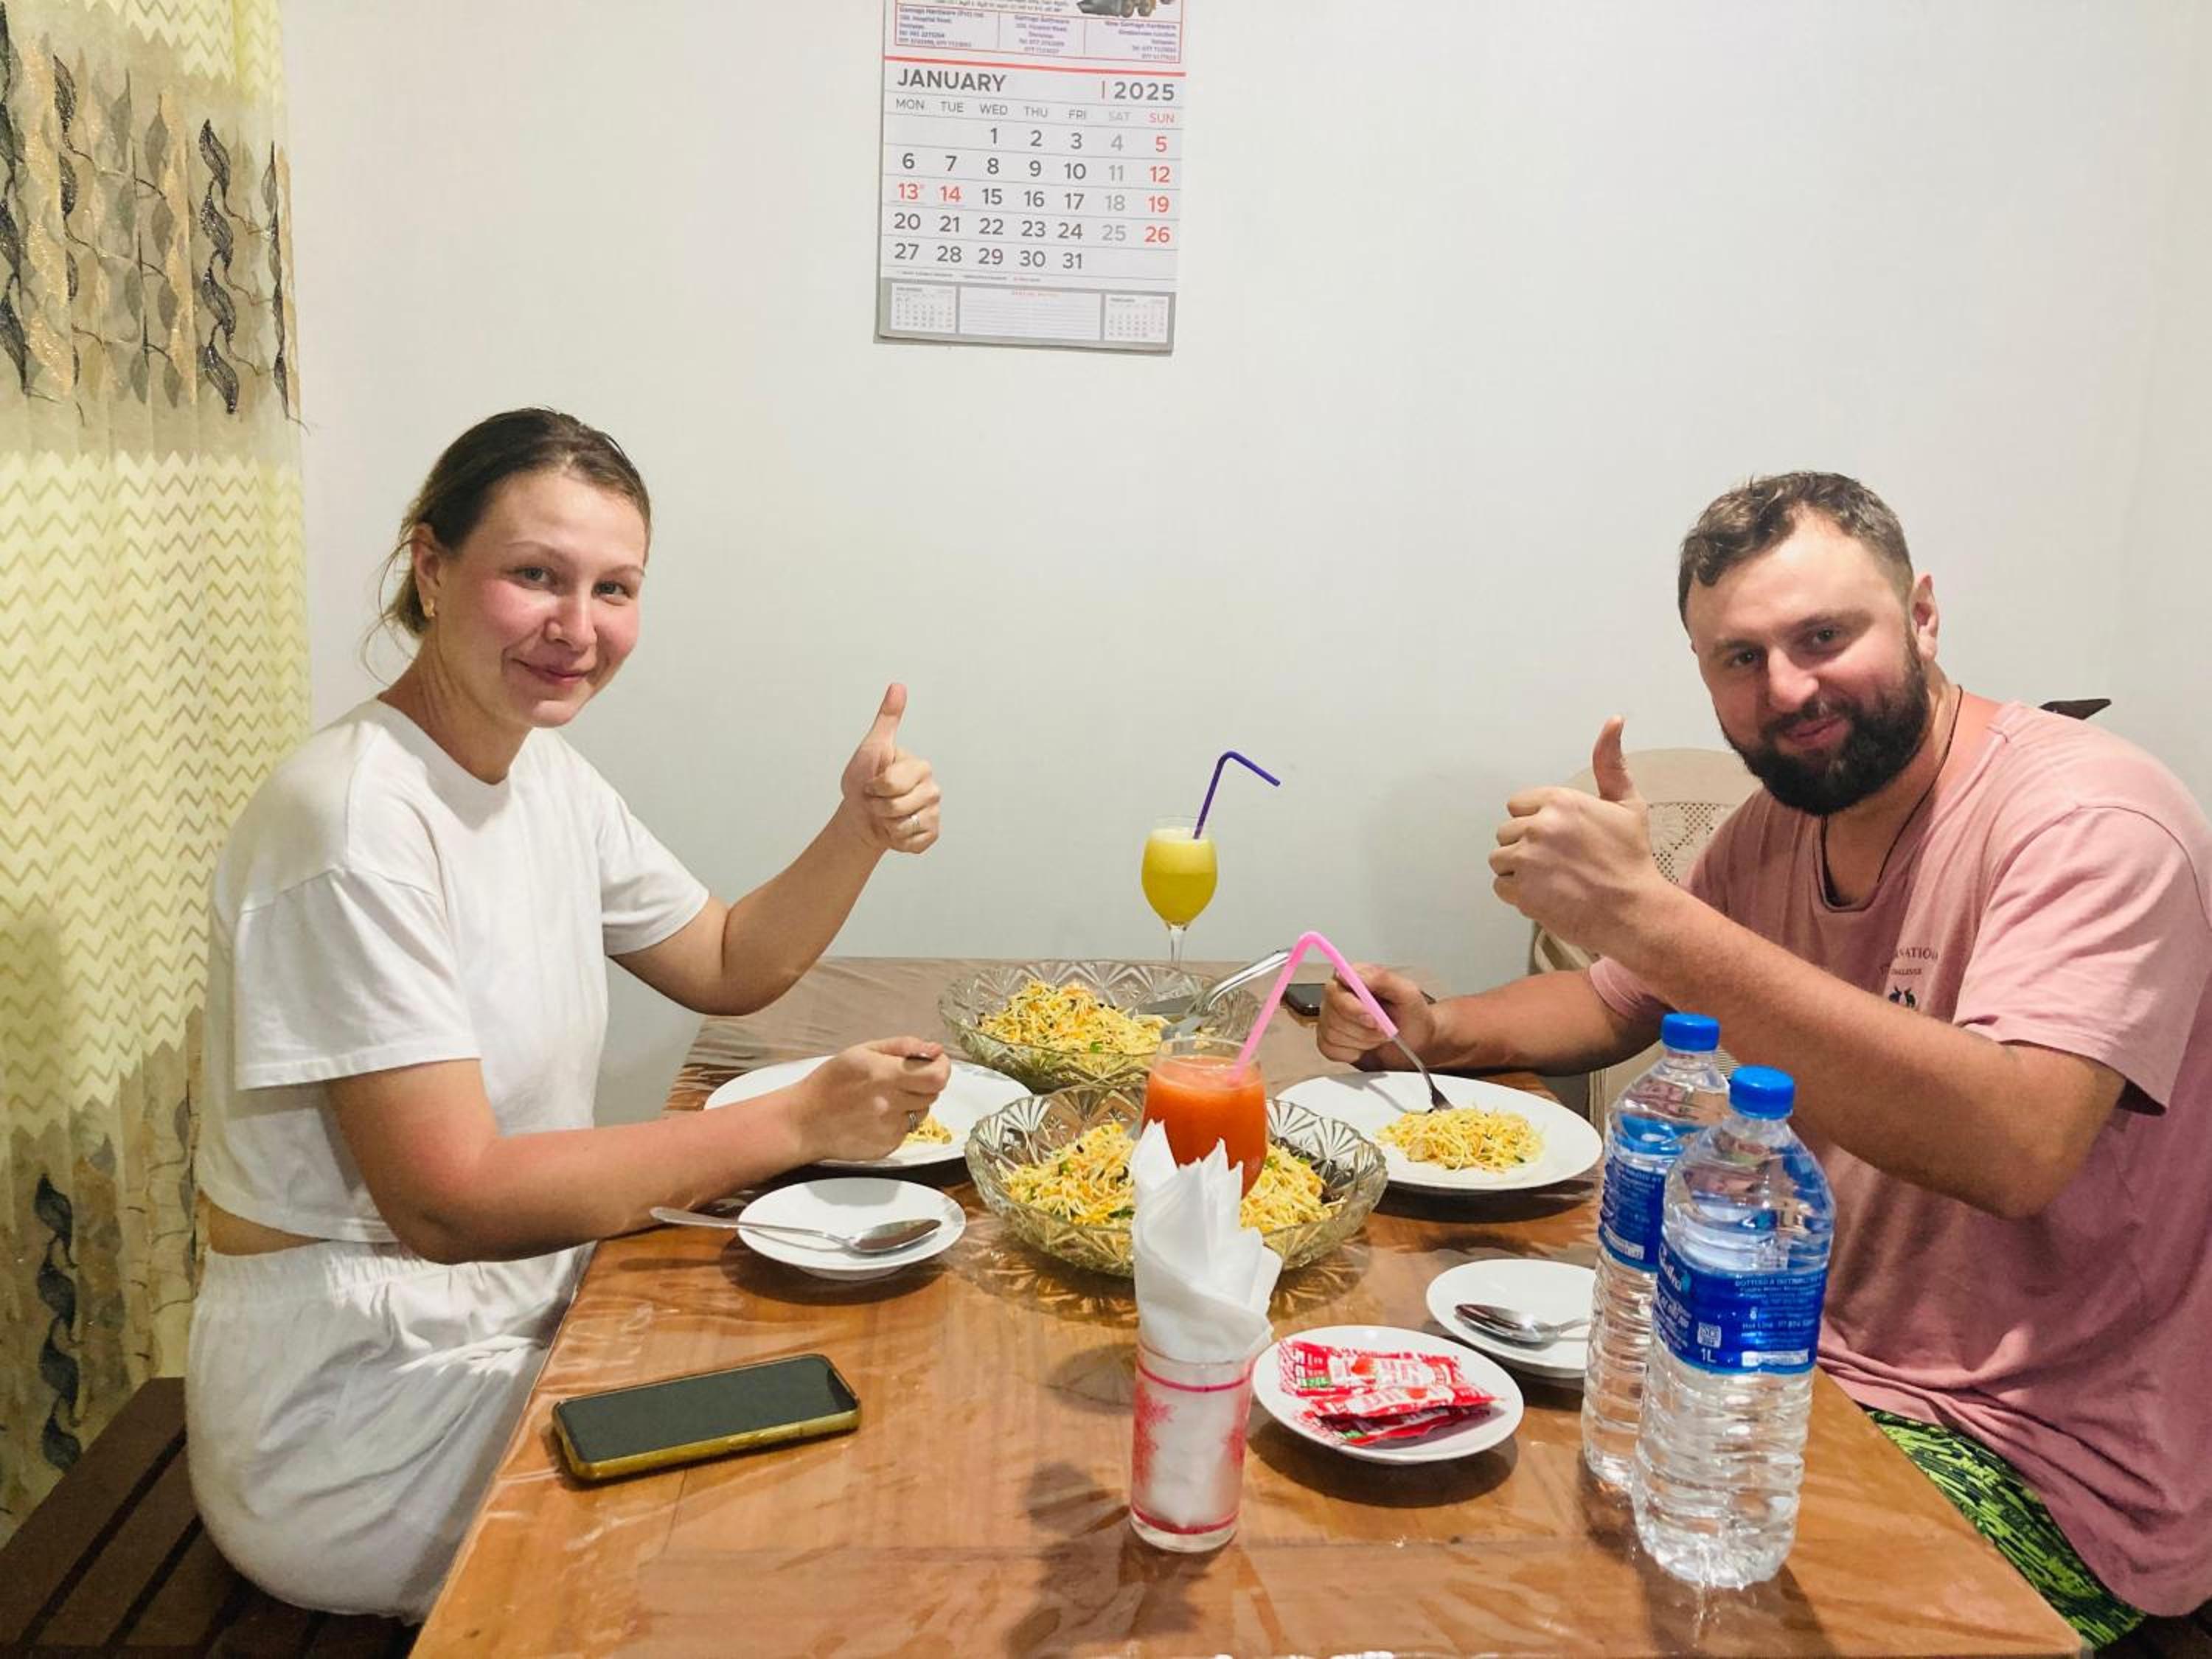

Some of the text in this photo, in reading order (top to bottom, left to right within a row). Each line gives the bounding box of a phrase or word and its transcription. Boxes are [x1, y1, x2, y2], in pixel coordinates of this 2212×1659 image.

[897, 69, 1175, 102] JANUARY 2025
[896, 97, 1175, 124] MON TUE WED THU FRI SAT SUN
[990, 127, 1167, 153] 1 2 3 4 5
[902, 152, 1170, 184] 6 7 8 9 10 11 12
[898, 182, 1169, 213] 13 14 15 16 17 18 19
[894, 212, 1170, 243] 20 21 22 23 24 25 26
[894, 242, 1082, 270] 27 28 29 30 31
[1700, 1347, 1717, 1363] 1L
